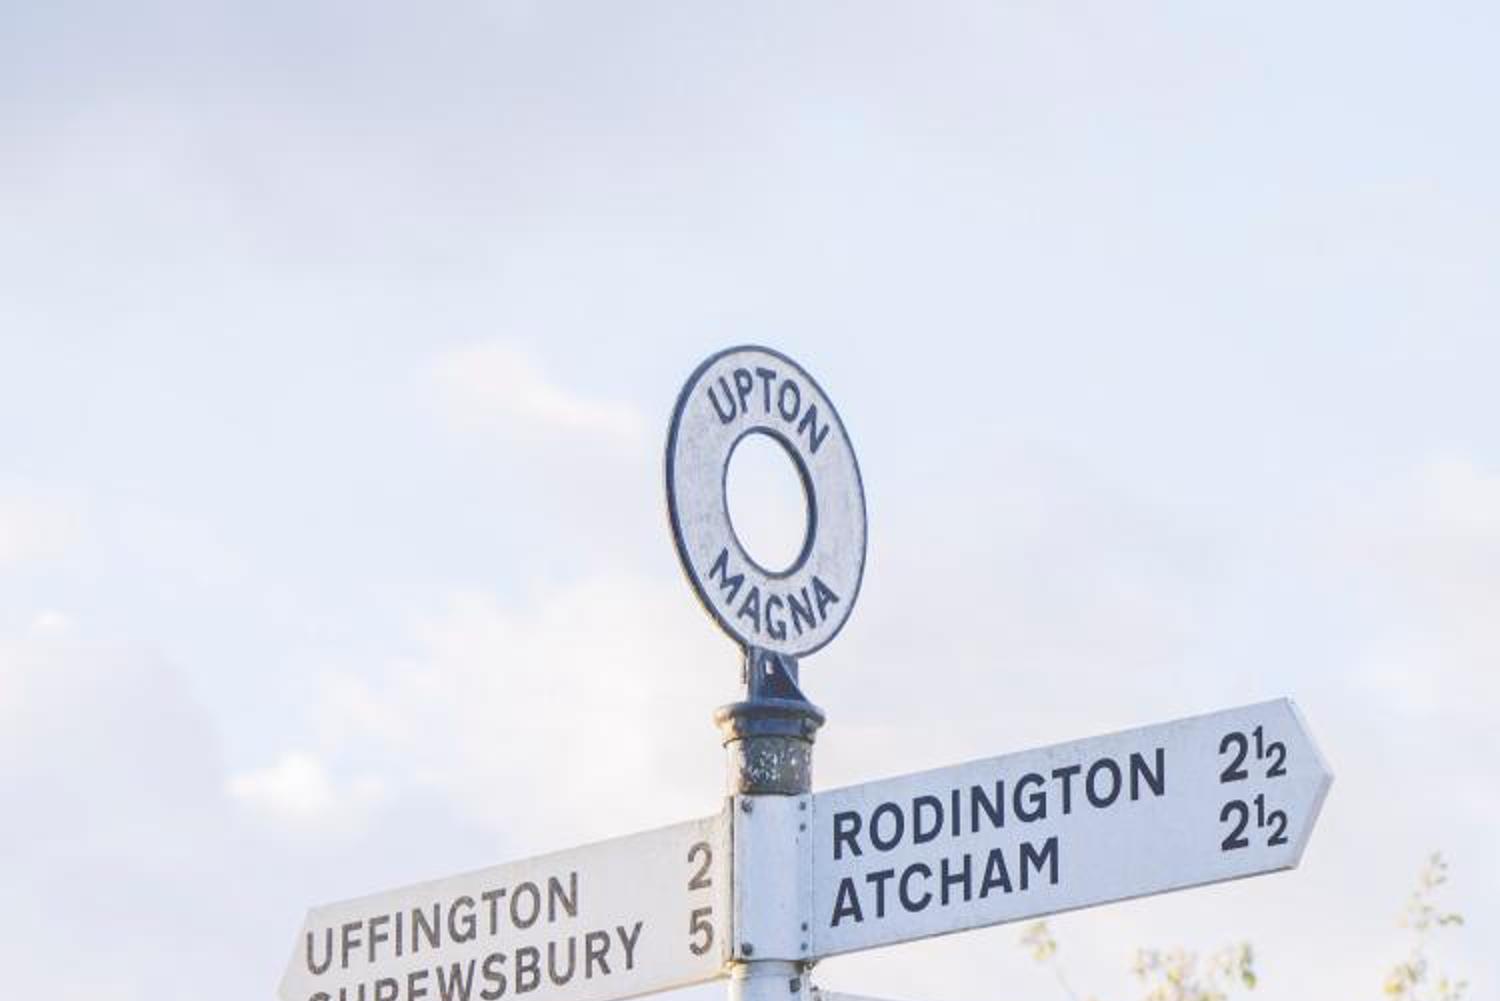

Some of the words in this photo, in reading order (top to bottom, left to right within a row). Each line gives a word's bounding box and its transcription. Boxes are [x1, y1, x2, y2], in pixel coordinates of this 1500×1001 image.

[708, 367, 830, 455] UPTON
[708, 548, 840, 641] MAGNA
[833, 747, 1165, 860] RODINGTON
[306, 872, 578, 975] UFFINGTON
[687, 842, 713, 891] 2
[831, 836, 1059, 926] ATCHAM
[688, 907, 714, 956] 5
